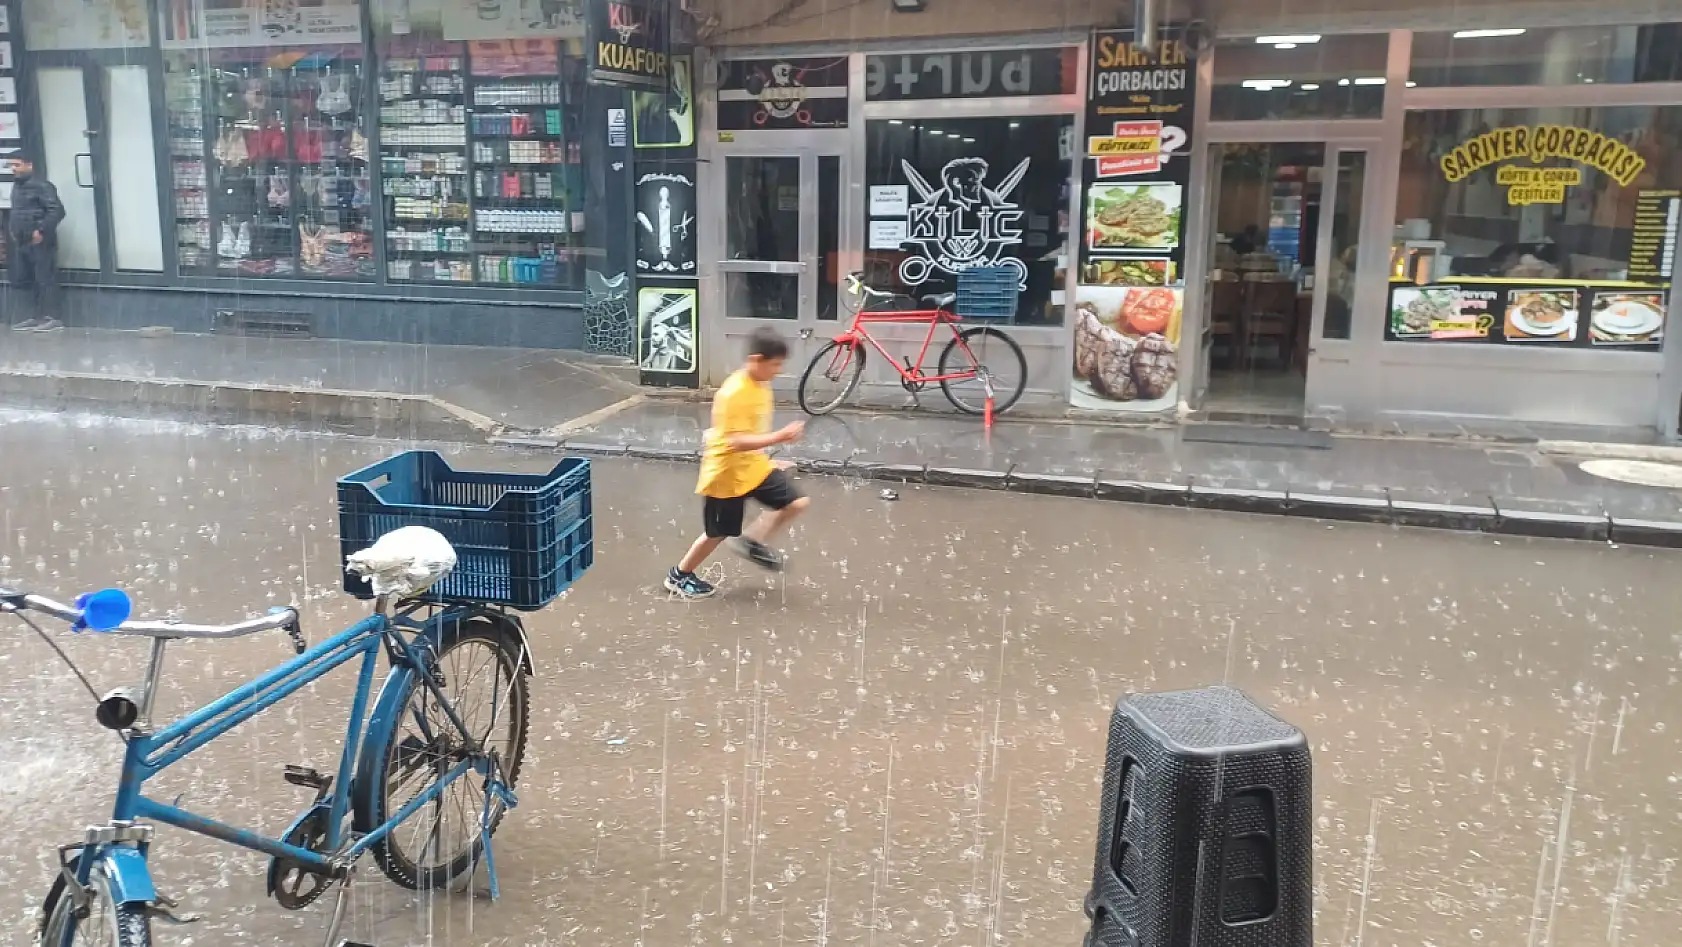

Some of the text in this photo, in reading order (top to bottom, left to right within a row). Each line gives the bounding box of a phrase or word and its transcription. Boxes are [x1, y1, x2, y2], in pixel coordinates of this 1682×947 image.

[1098, 68, 1186, 97] ÇORBACISI
[1442, 126, 1645, 184] SARIYER ÇORBACISI
